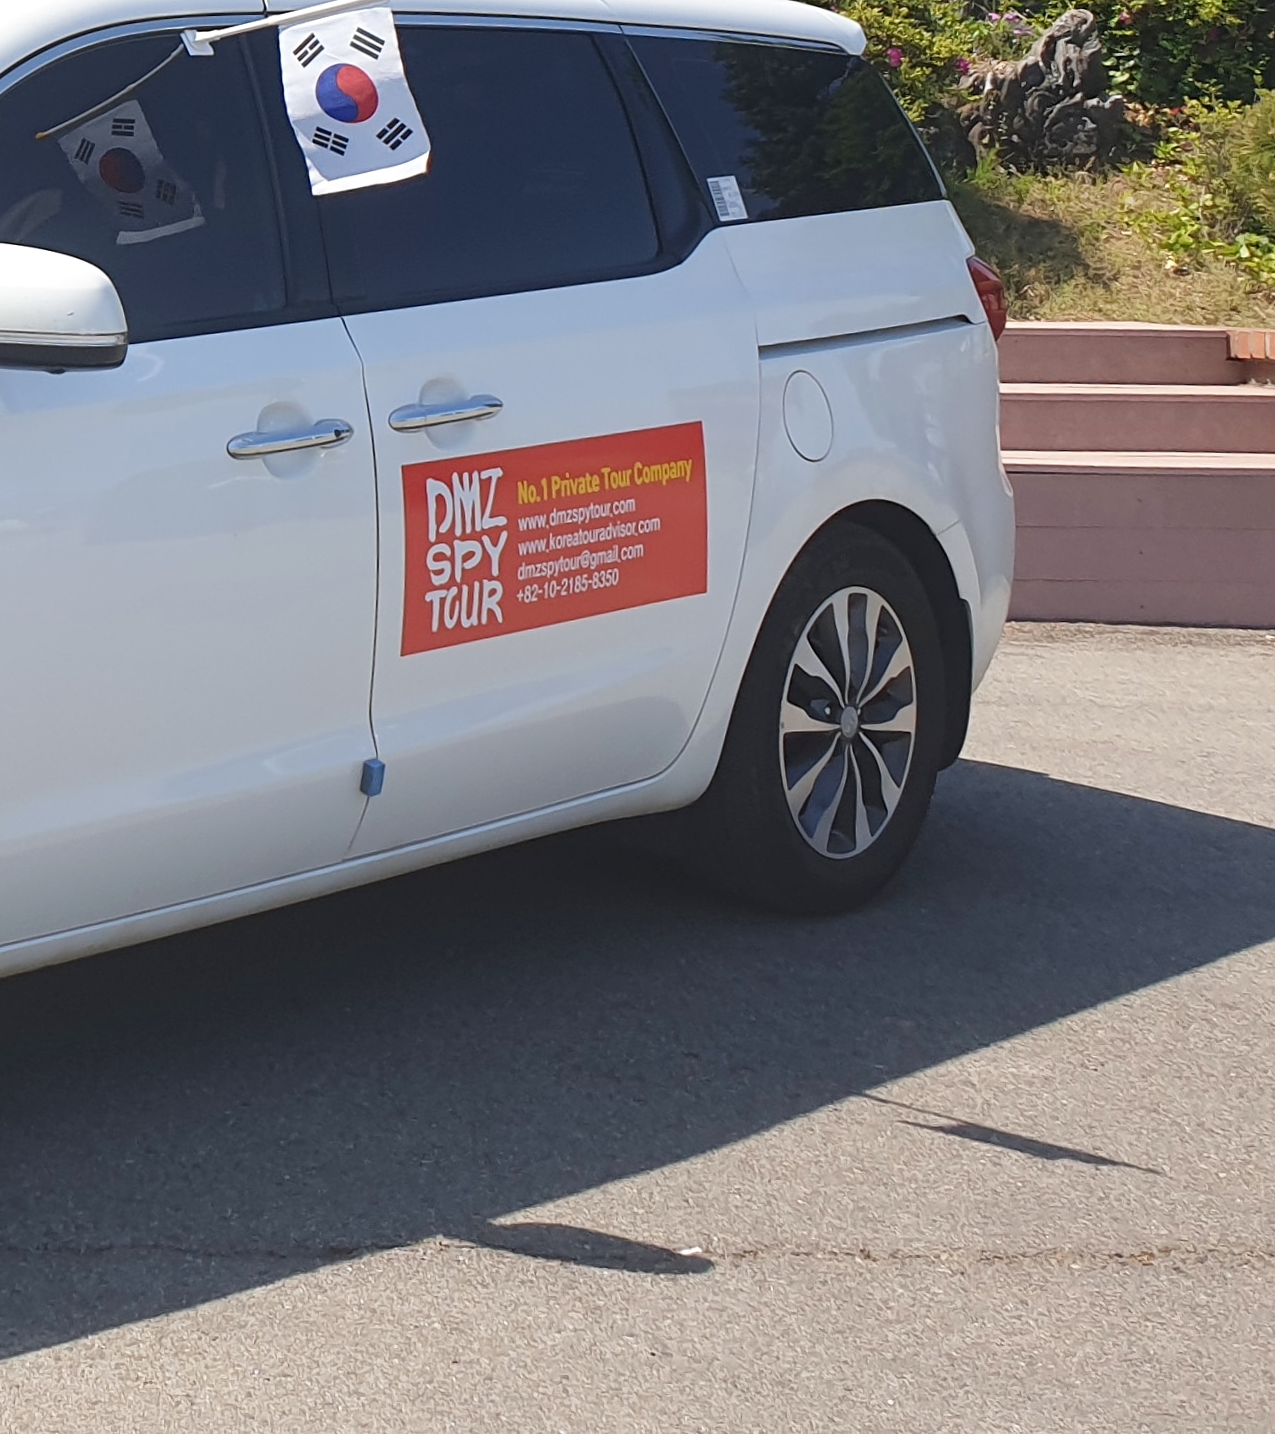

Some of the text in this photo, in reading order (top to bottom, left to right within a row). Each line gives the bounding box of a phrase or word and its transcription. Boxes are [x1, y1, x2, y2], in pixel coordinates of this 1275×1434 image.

[552, 472, 600, 498] Private
[601, 467, 632, 491] Tour
[634, 459, 692, 486] Company
[425, 467, 508, 542] DMZ
[426, 531, 508, 586] SPY
[517, 544, 644, 580] dmzspytour@gmail.com
[425, 580, 503, 632] TOUR
[516, 568, 619, 603] +82-10-2185-8350
